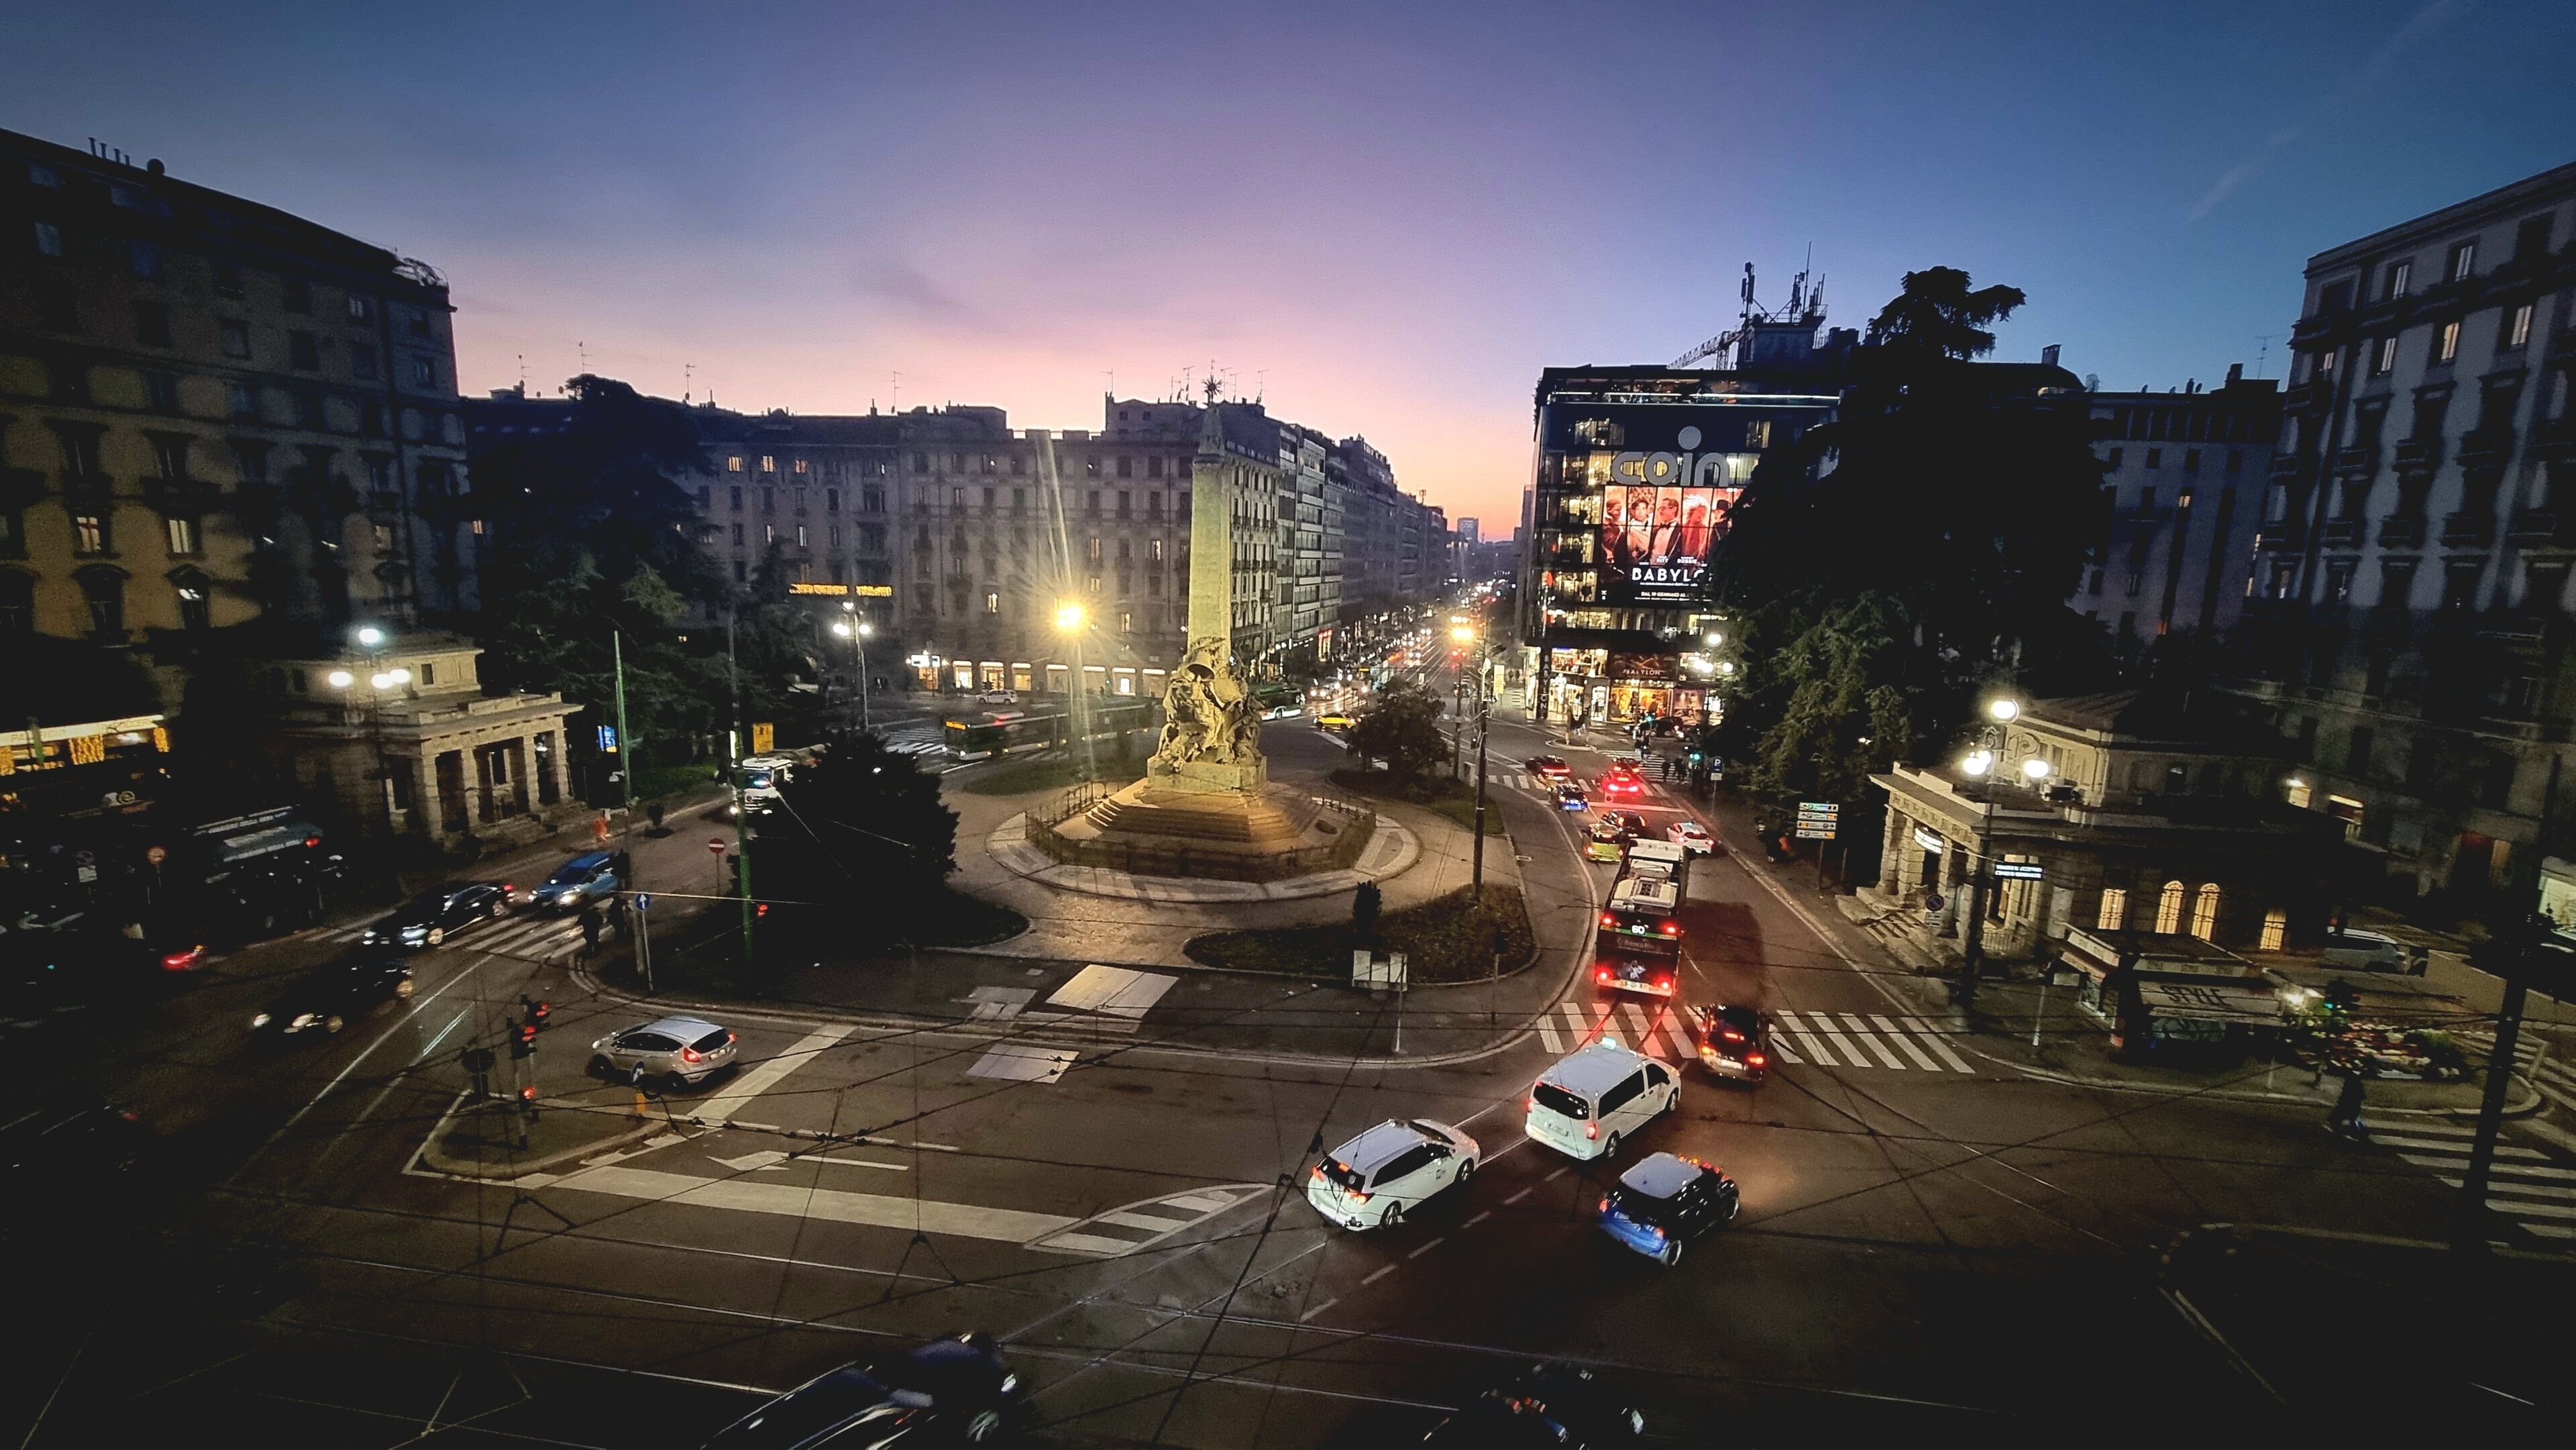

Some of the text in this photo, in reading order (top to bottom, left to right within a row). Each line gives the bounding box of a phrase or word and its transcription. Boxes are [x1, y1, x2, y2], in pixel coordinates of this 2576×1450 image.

[1611, 425, 1730, 487] coin
[1631, 567, 1705, 582] BABYL
[1631, 925, 1646, 935] 60
